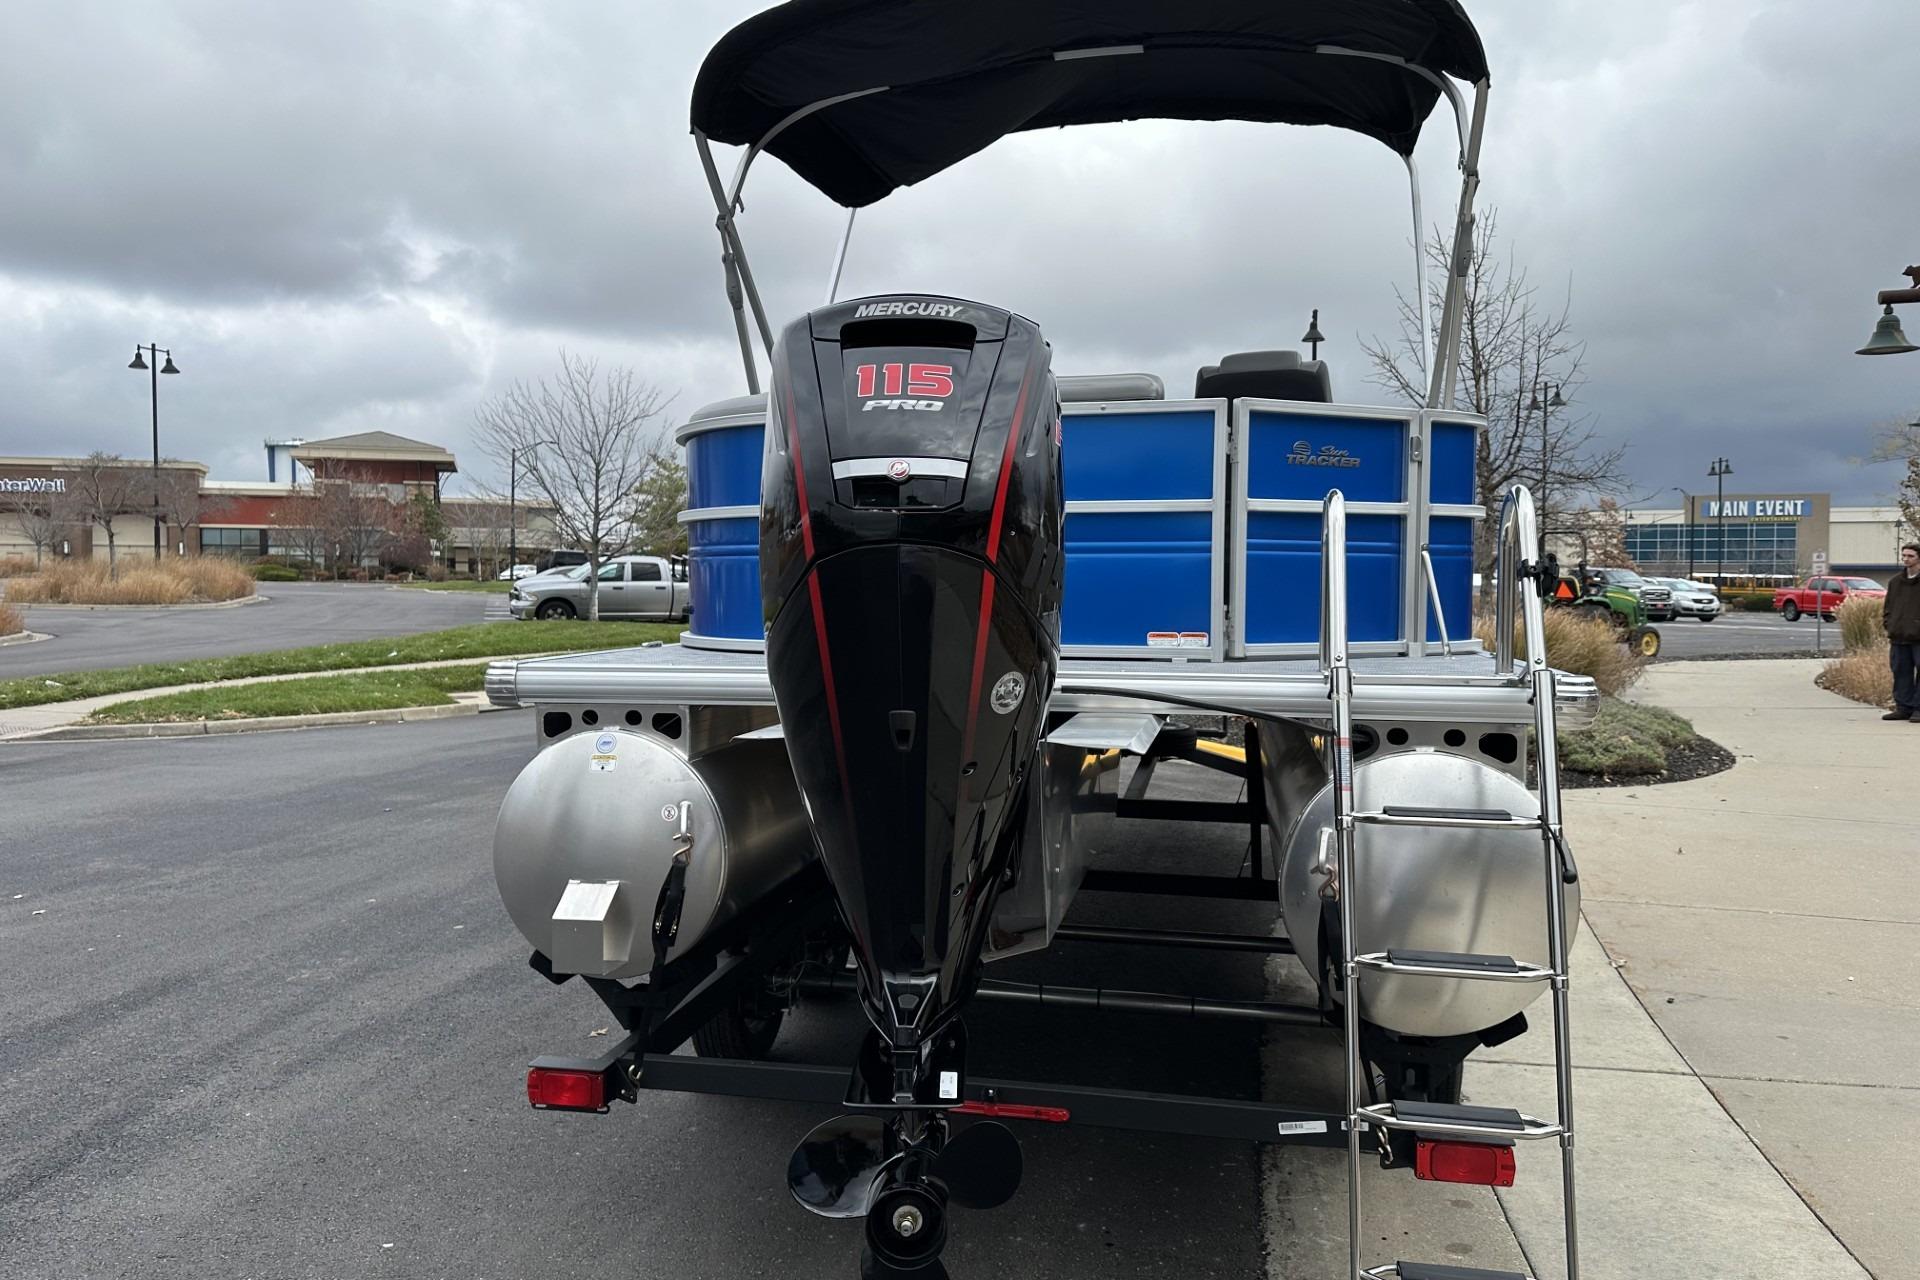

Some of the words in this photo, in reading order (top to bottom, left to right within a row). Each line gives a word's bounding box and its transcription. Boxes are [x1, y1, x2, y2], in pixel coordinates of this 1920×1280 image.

[855, 302, 963, 318] MERCURY
[856, 363, 954, 398] 115
[862, 400, 945, 412] PRO
[1317, 445, 1350, 456] Sun
[1286, 454, 1361, 468] TRACKER
[1709, 501, 1749, 516] MAIN
[1755, 500, 1804, 515] EVENT
